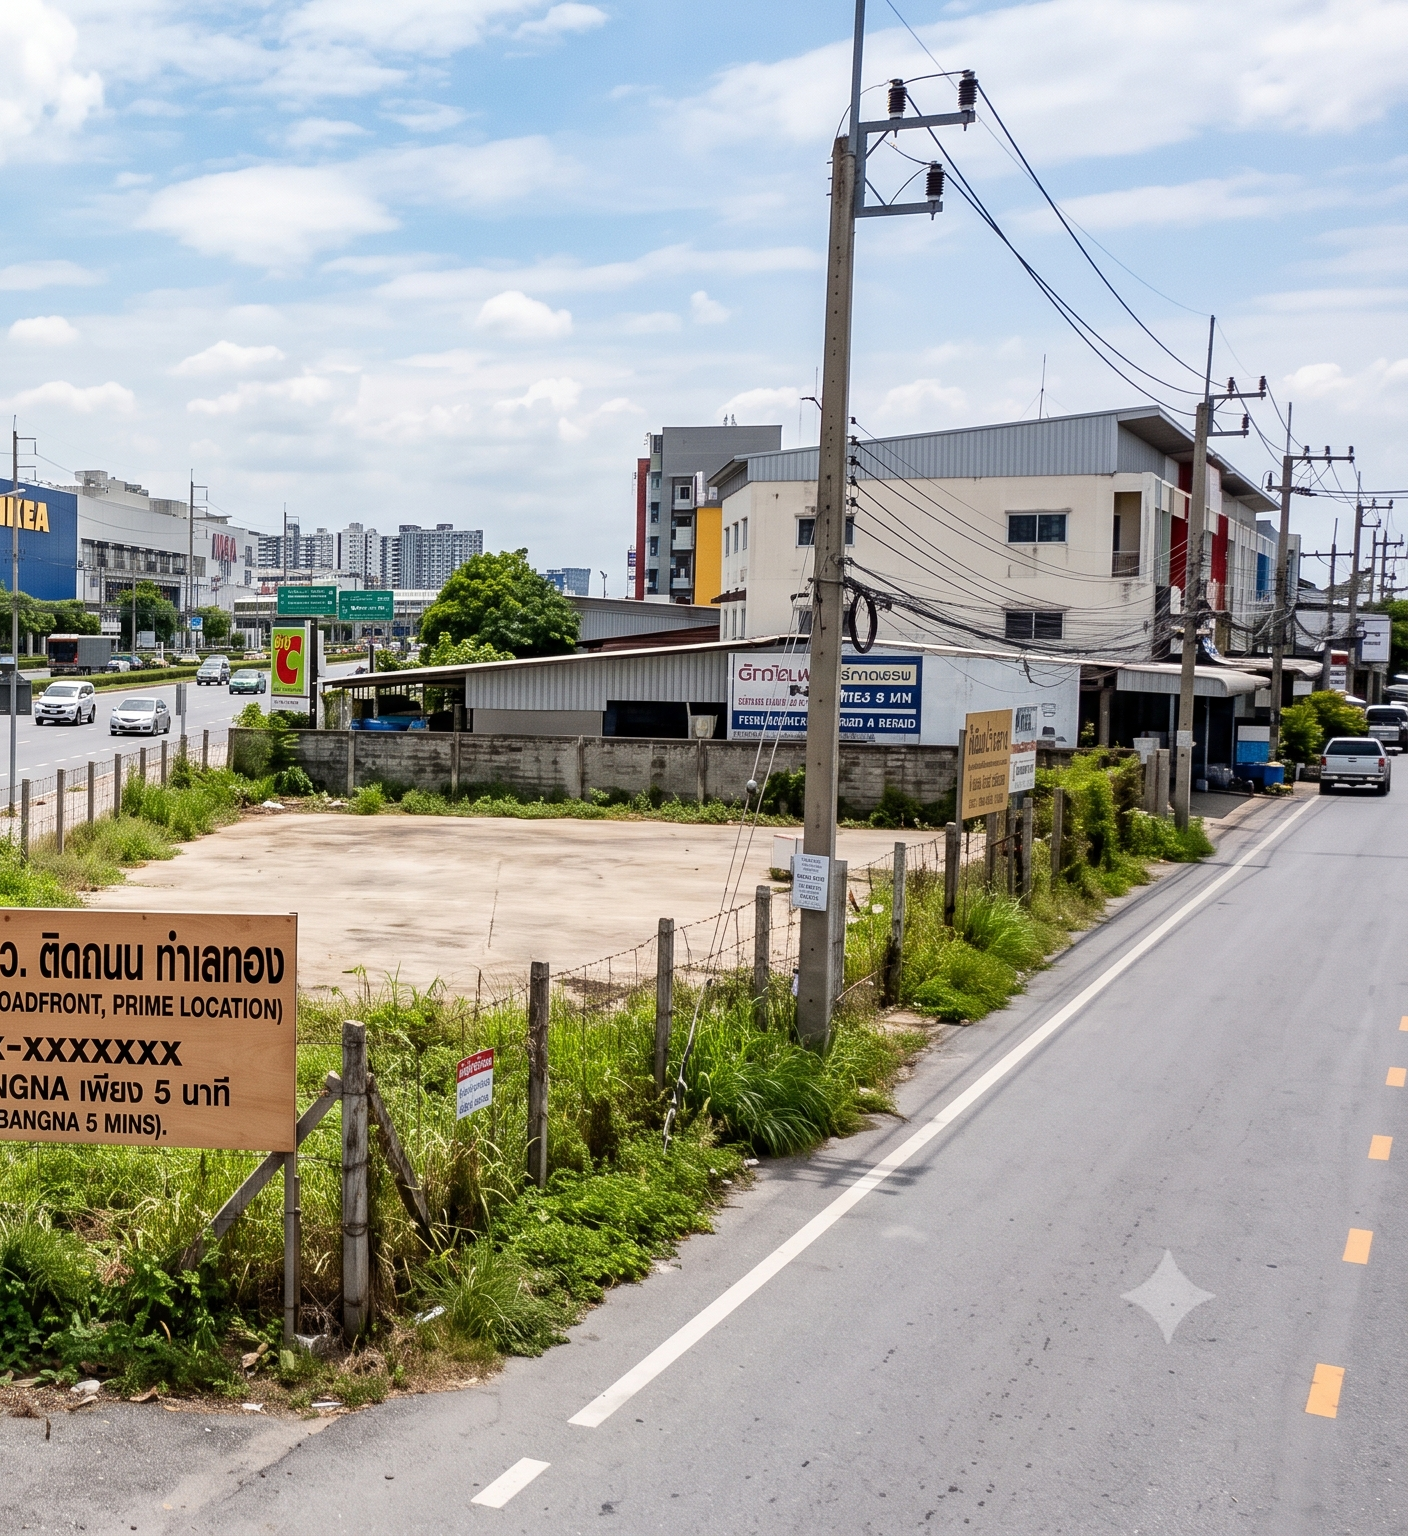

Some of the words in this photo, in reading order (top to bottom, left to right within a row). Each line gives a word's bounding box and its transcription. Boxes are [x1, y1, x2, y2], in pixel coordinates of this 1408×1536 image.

[39, 932, 144, 981] ติดถนน
[156, 930, 285, 985] ทำเลทอง
[113, 994, 174, 1017] PRIME
[180, 996, 283, 1025] LOCATION)
[80, 1073, 143, 1103] เพียง
[154, 1079, 171, 1104] 5
[182, 1076, 230, 1107] นาที
[85, 1112, 98, 1133] 5
[104, 1113, 167, 1141] MINS).
